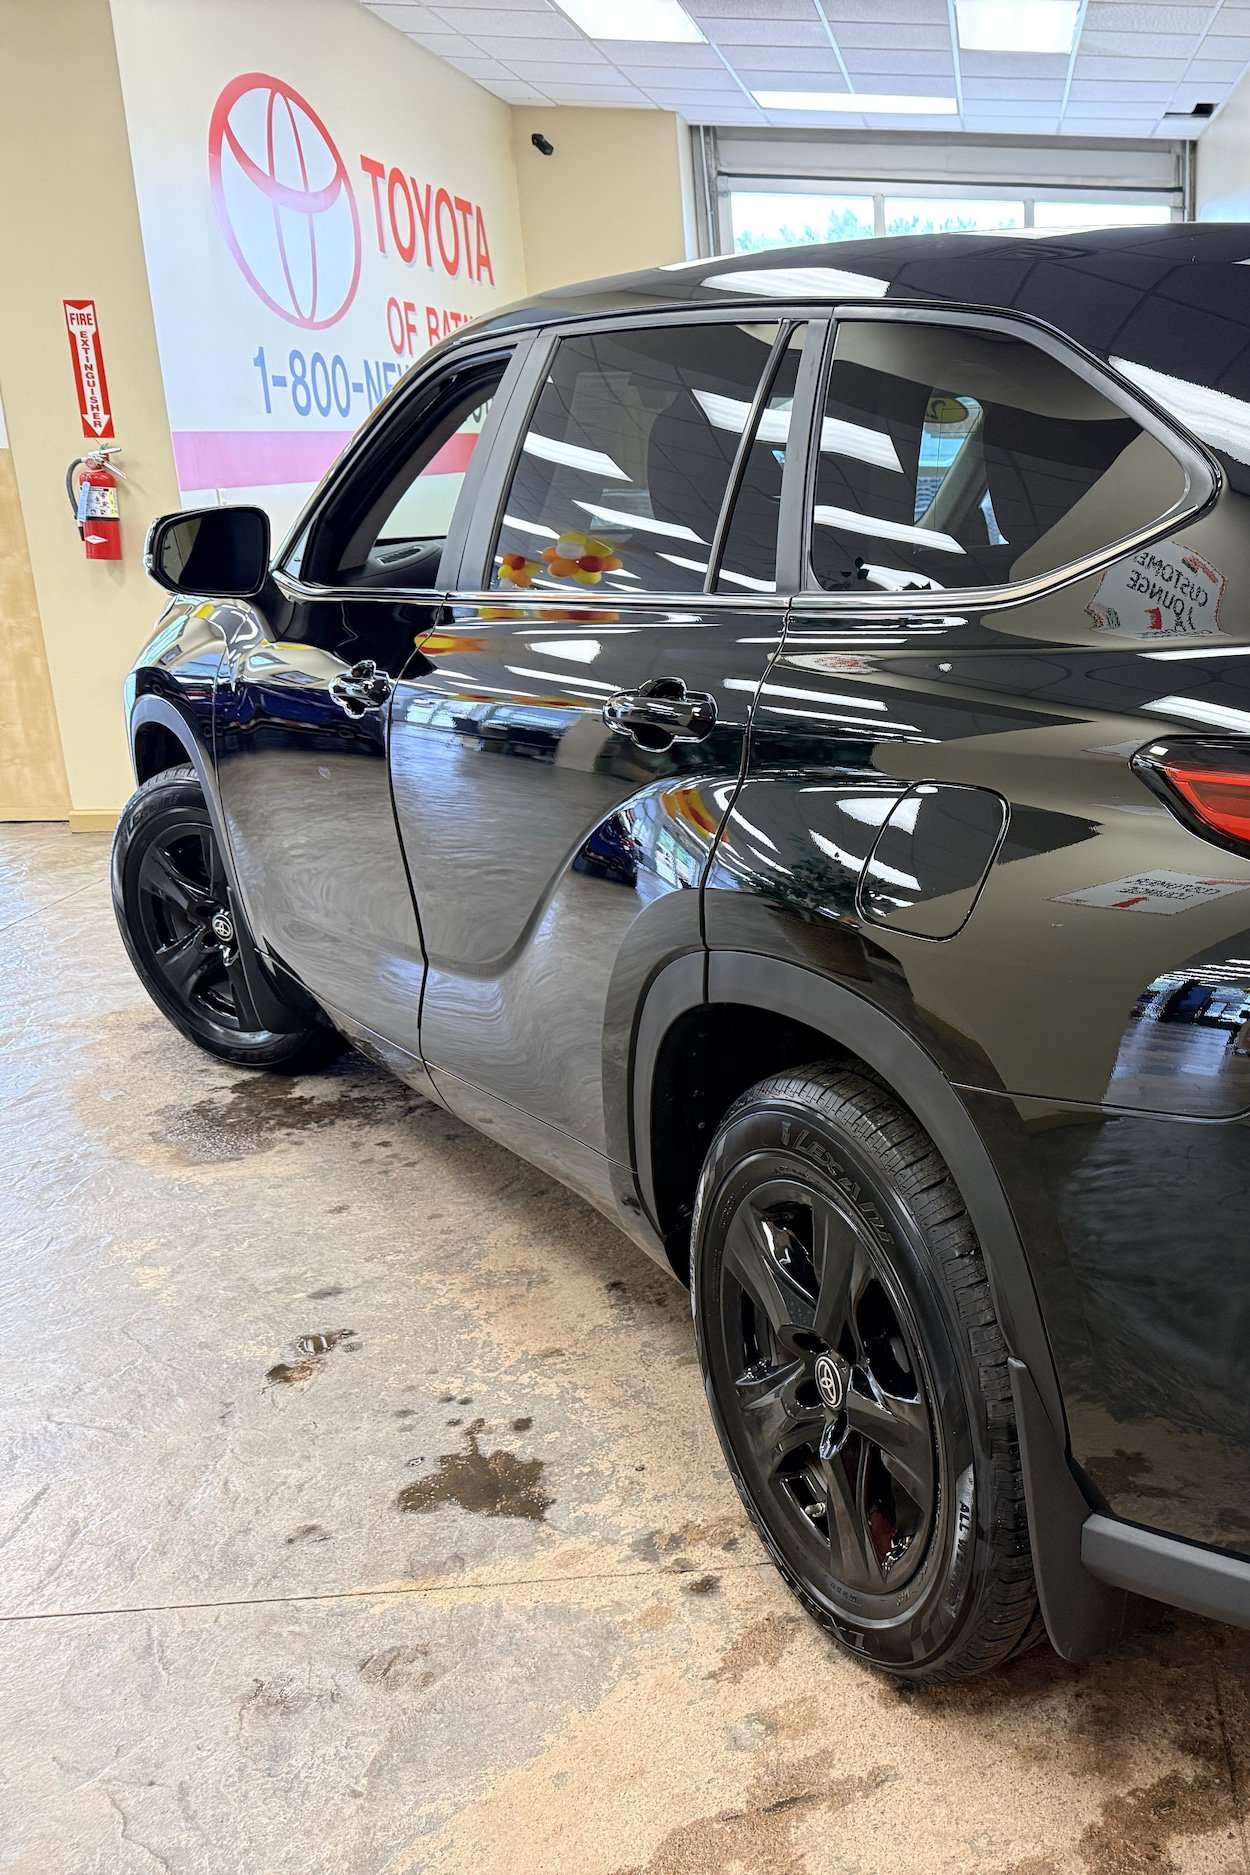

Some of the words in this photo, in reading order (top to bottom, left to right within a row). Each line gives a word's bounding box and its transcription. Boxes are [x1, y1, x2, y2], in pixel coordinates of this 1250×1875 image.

[360, 154, 496, 287] TOYOTA
[69, 312, 94, 326] FIRE
[387, 297, 417, 356] OF
[79, 330, 102, 428] EXTINGUISHER
[253, 346, 409, 418] 1-800-NE
